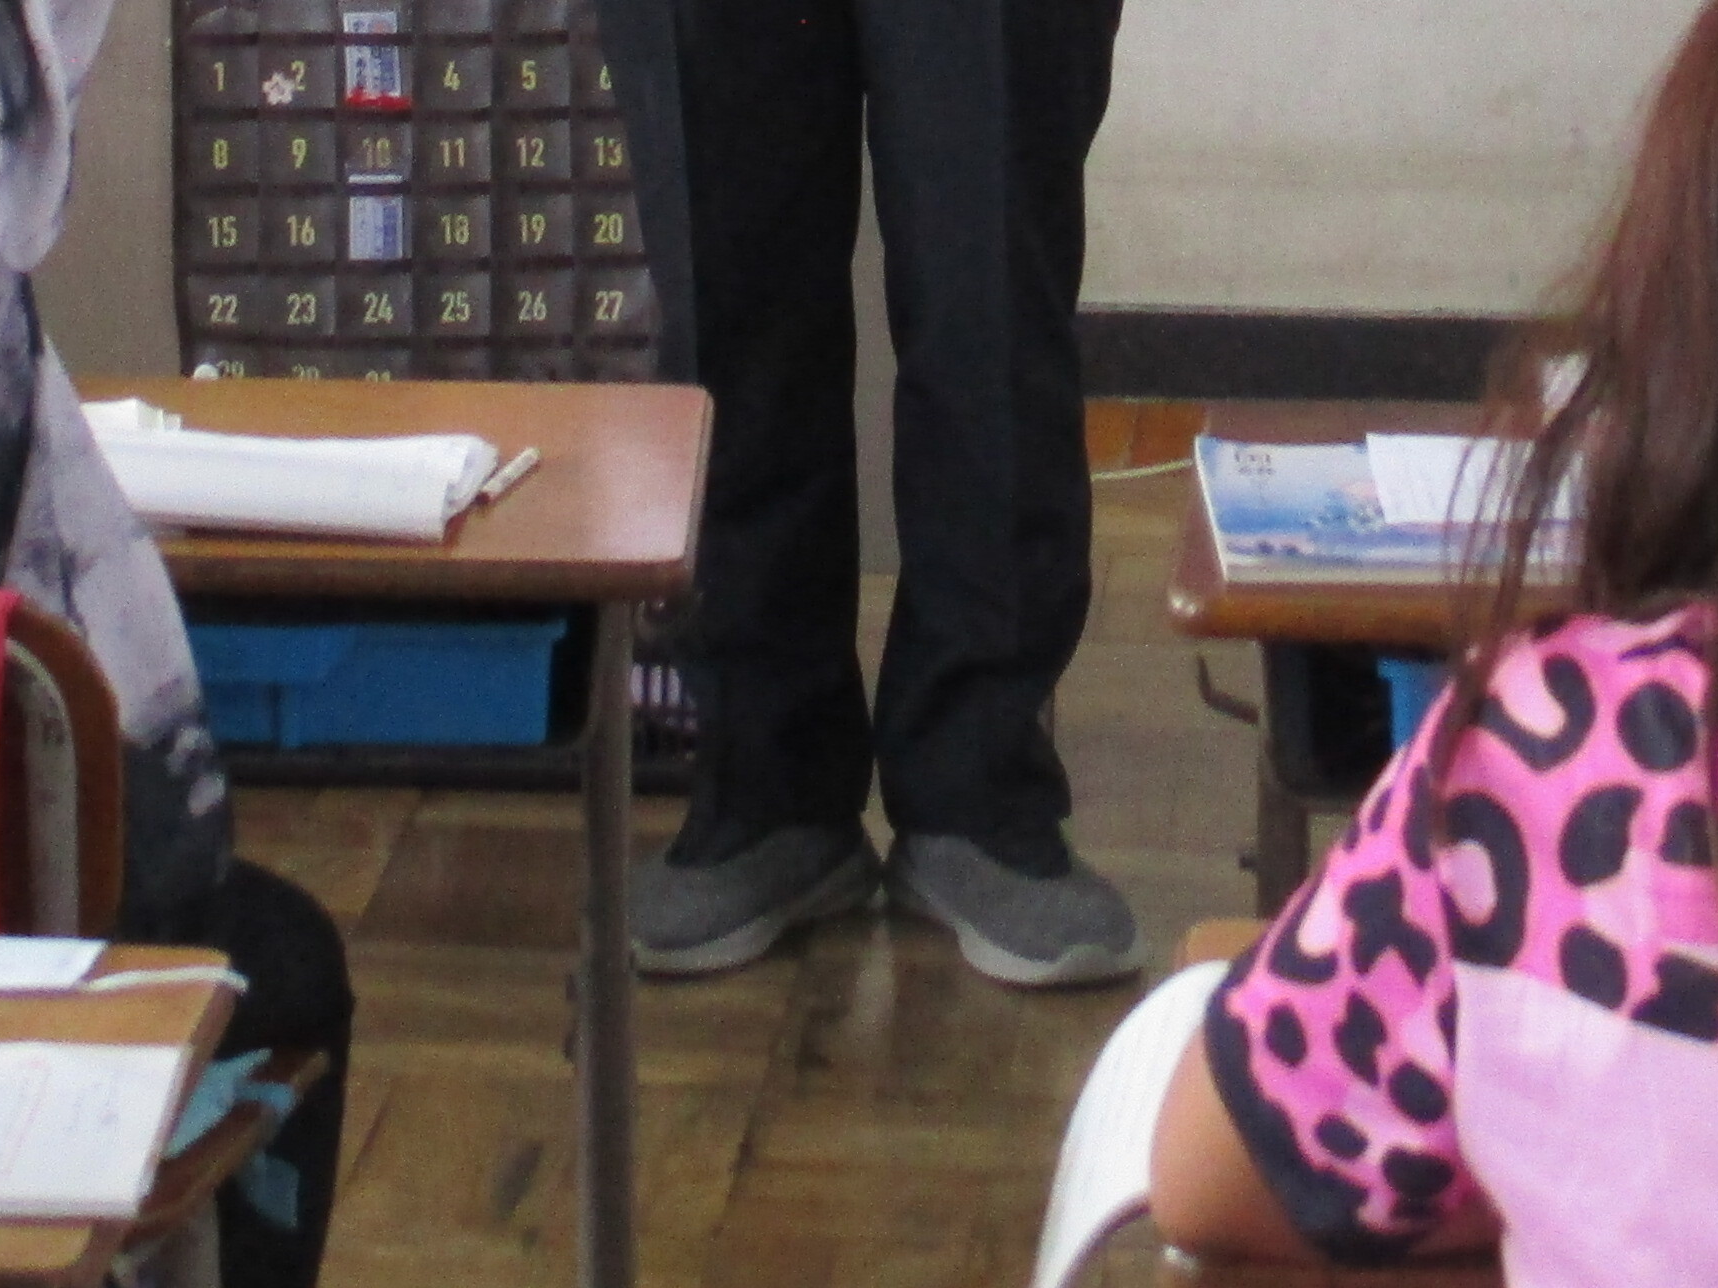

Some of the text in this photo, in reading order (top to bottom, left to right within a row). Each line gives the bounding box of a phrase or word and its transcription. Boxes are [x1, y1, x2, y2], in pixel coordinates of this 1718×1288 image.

[213, 61, 225, 91] 1
[291, 61, 307, 91] 2
[444, 61, 461, 91] 4
[522, 61, 537, 91] 5
[291, 138, 307, 169] 9
[438, 138, 466, 168] 11
[517, 137, 546, 168] 12
[209, 217, 237, 247] 15
[287, 217, 315, 247] 16
[441, 214, 470, 245] 18
[519, 214, 546, 245] 19
[594, 213, 624, 244] 20
[209, 291, 625, 325] 22 23 24 25 26 27
